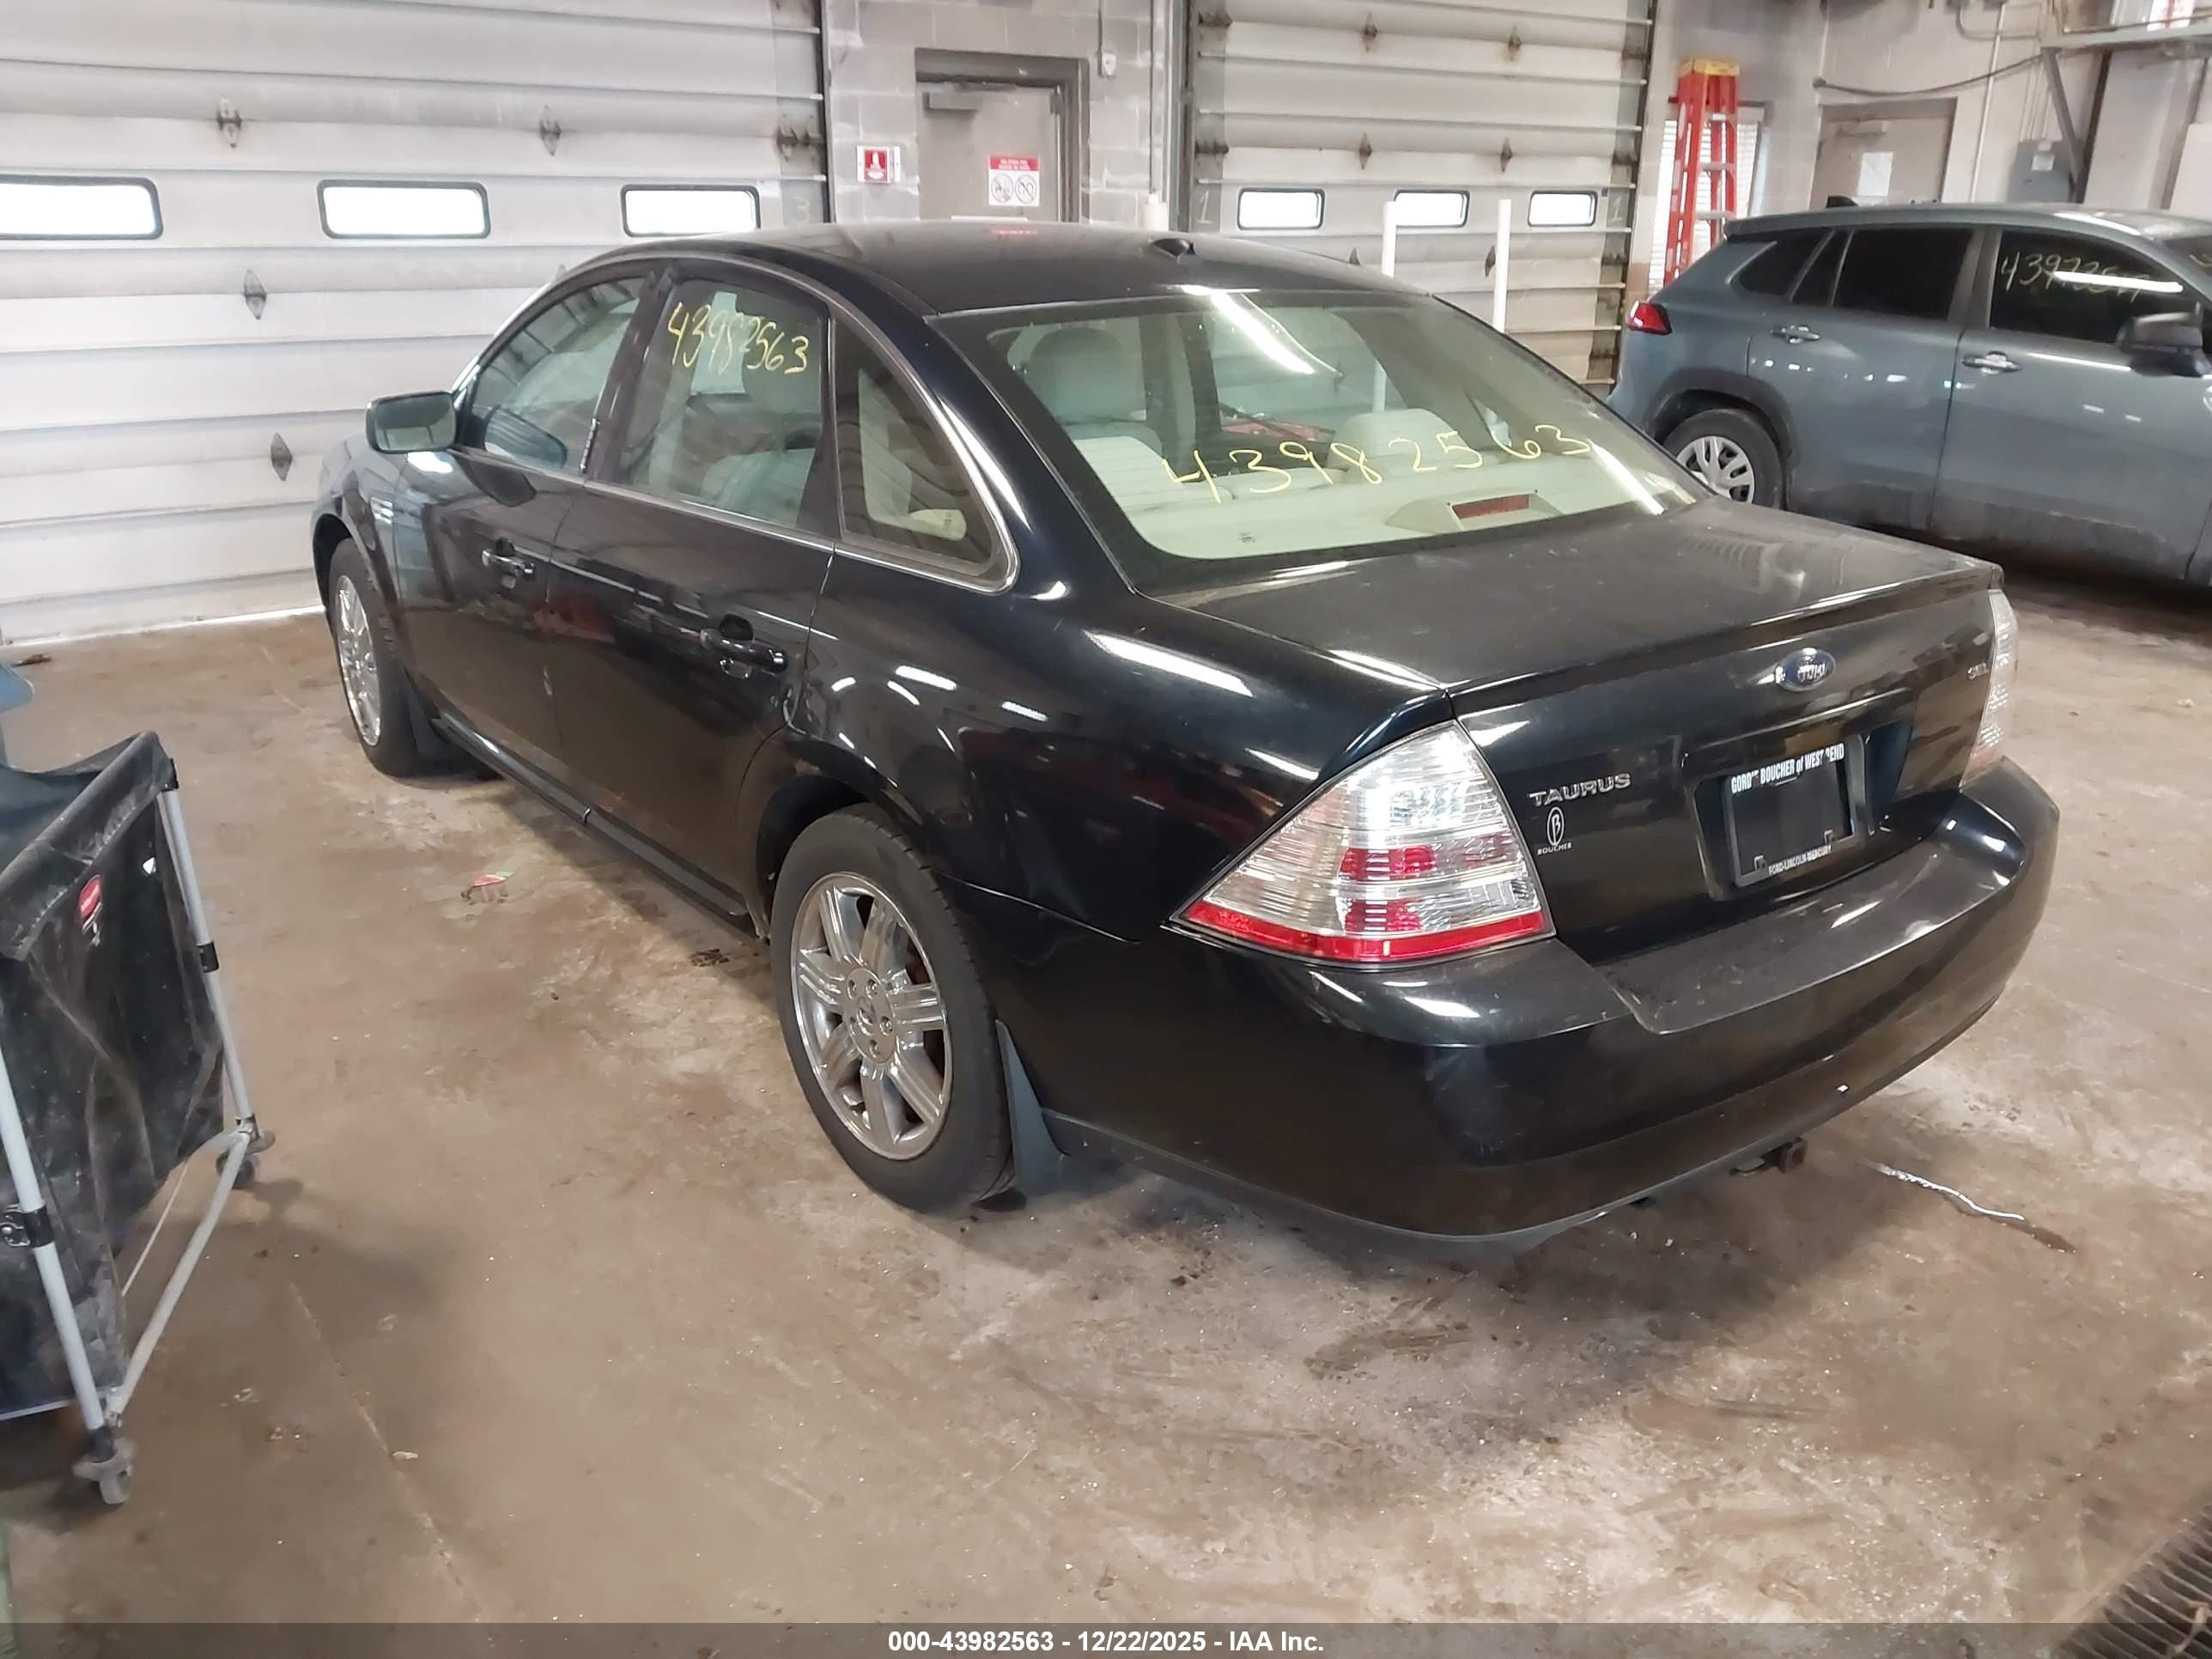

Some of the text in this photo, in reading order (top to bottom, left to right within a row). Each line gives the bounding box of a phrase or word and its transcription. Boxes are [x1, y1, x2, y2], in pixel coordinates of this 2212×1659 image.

[667, 301, 809, 374] 43982563
[1760, 758, 1796, 785] BOUCHER
[1796, 756, 1804, 775] of
[1804, 749, 1825, 770] WEST
[1528, 773, 1631, 806] TAURUS
[1537, 842, 1572, 855] BOUCHER
